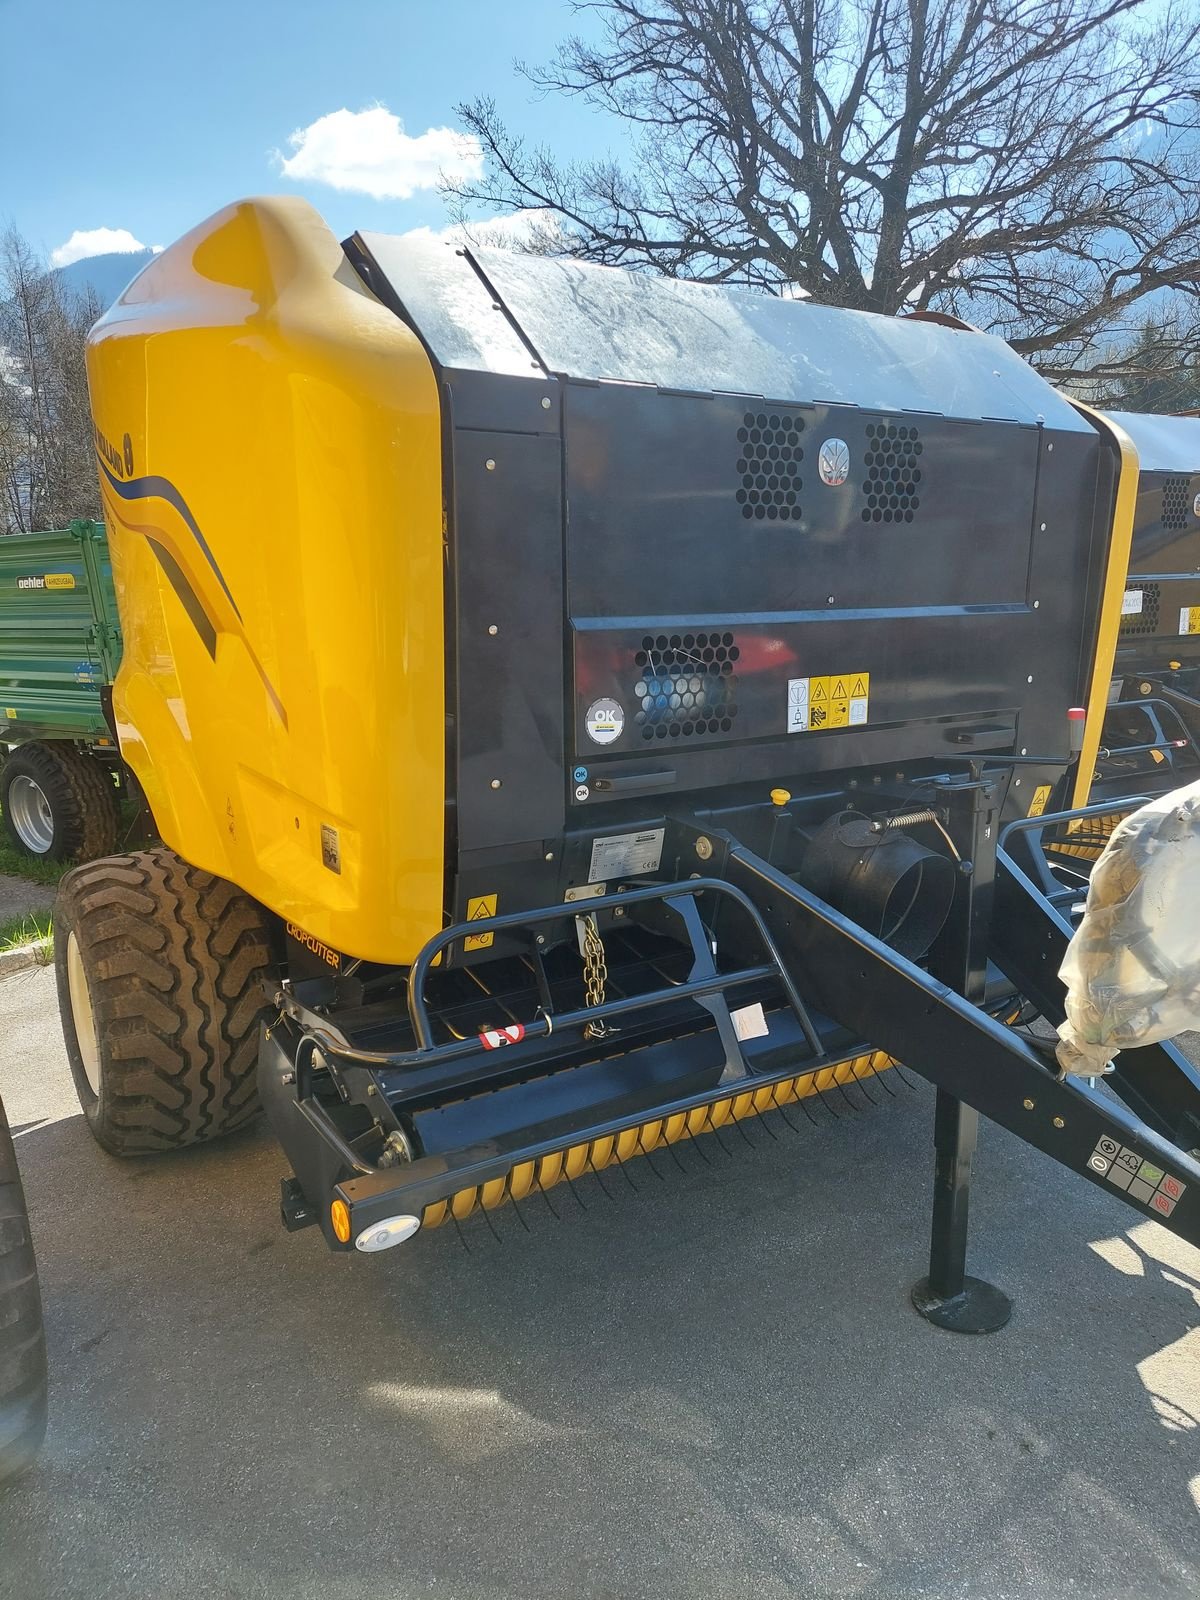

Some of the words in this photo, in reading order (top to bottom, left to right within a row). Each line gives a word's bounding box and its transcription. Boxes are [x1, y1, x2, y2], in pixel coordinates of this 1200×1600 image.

[18, 576, 44, 589] oehler
[594, 709, 616, 723] OK
[577, 789, 588, 797] OK
[286, 921, 340, 969] CROPCUTTER
